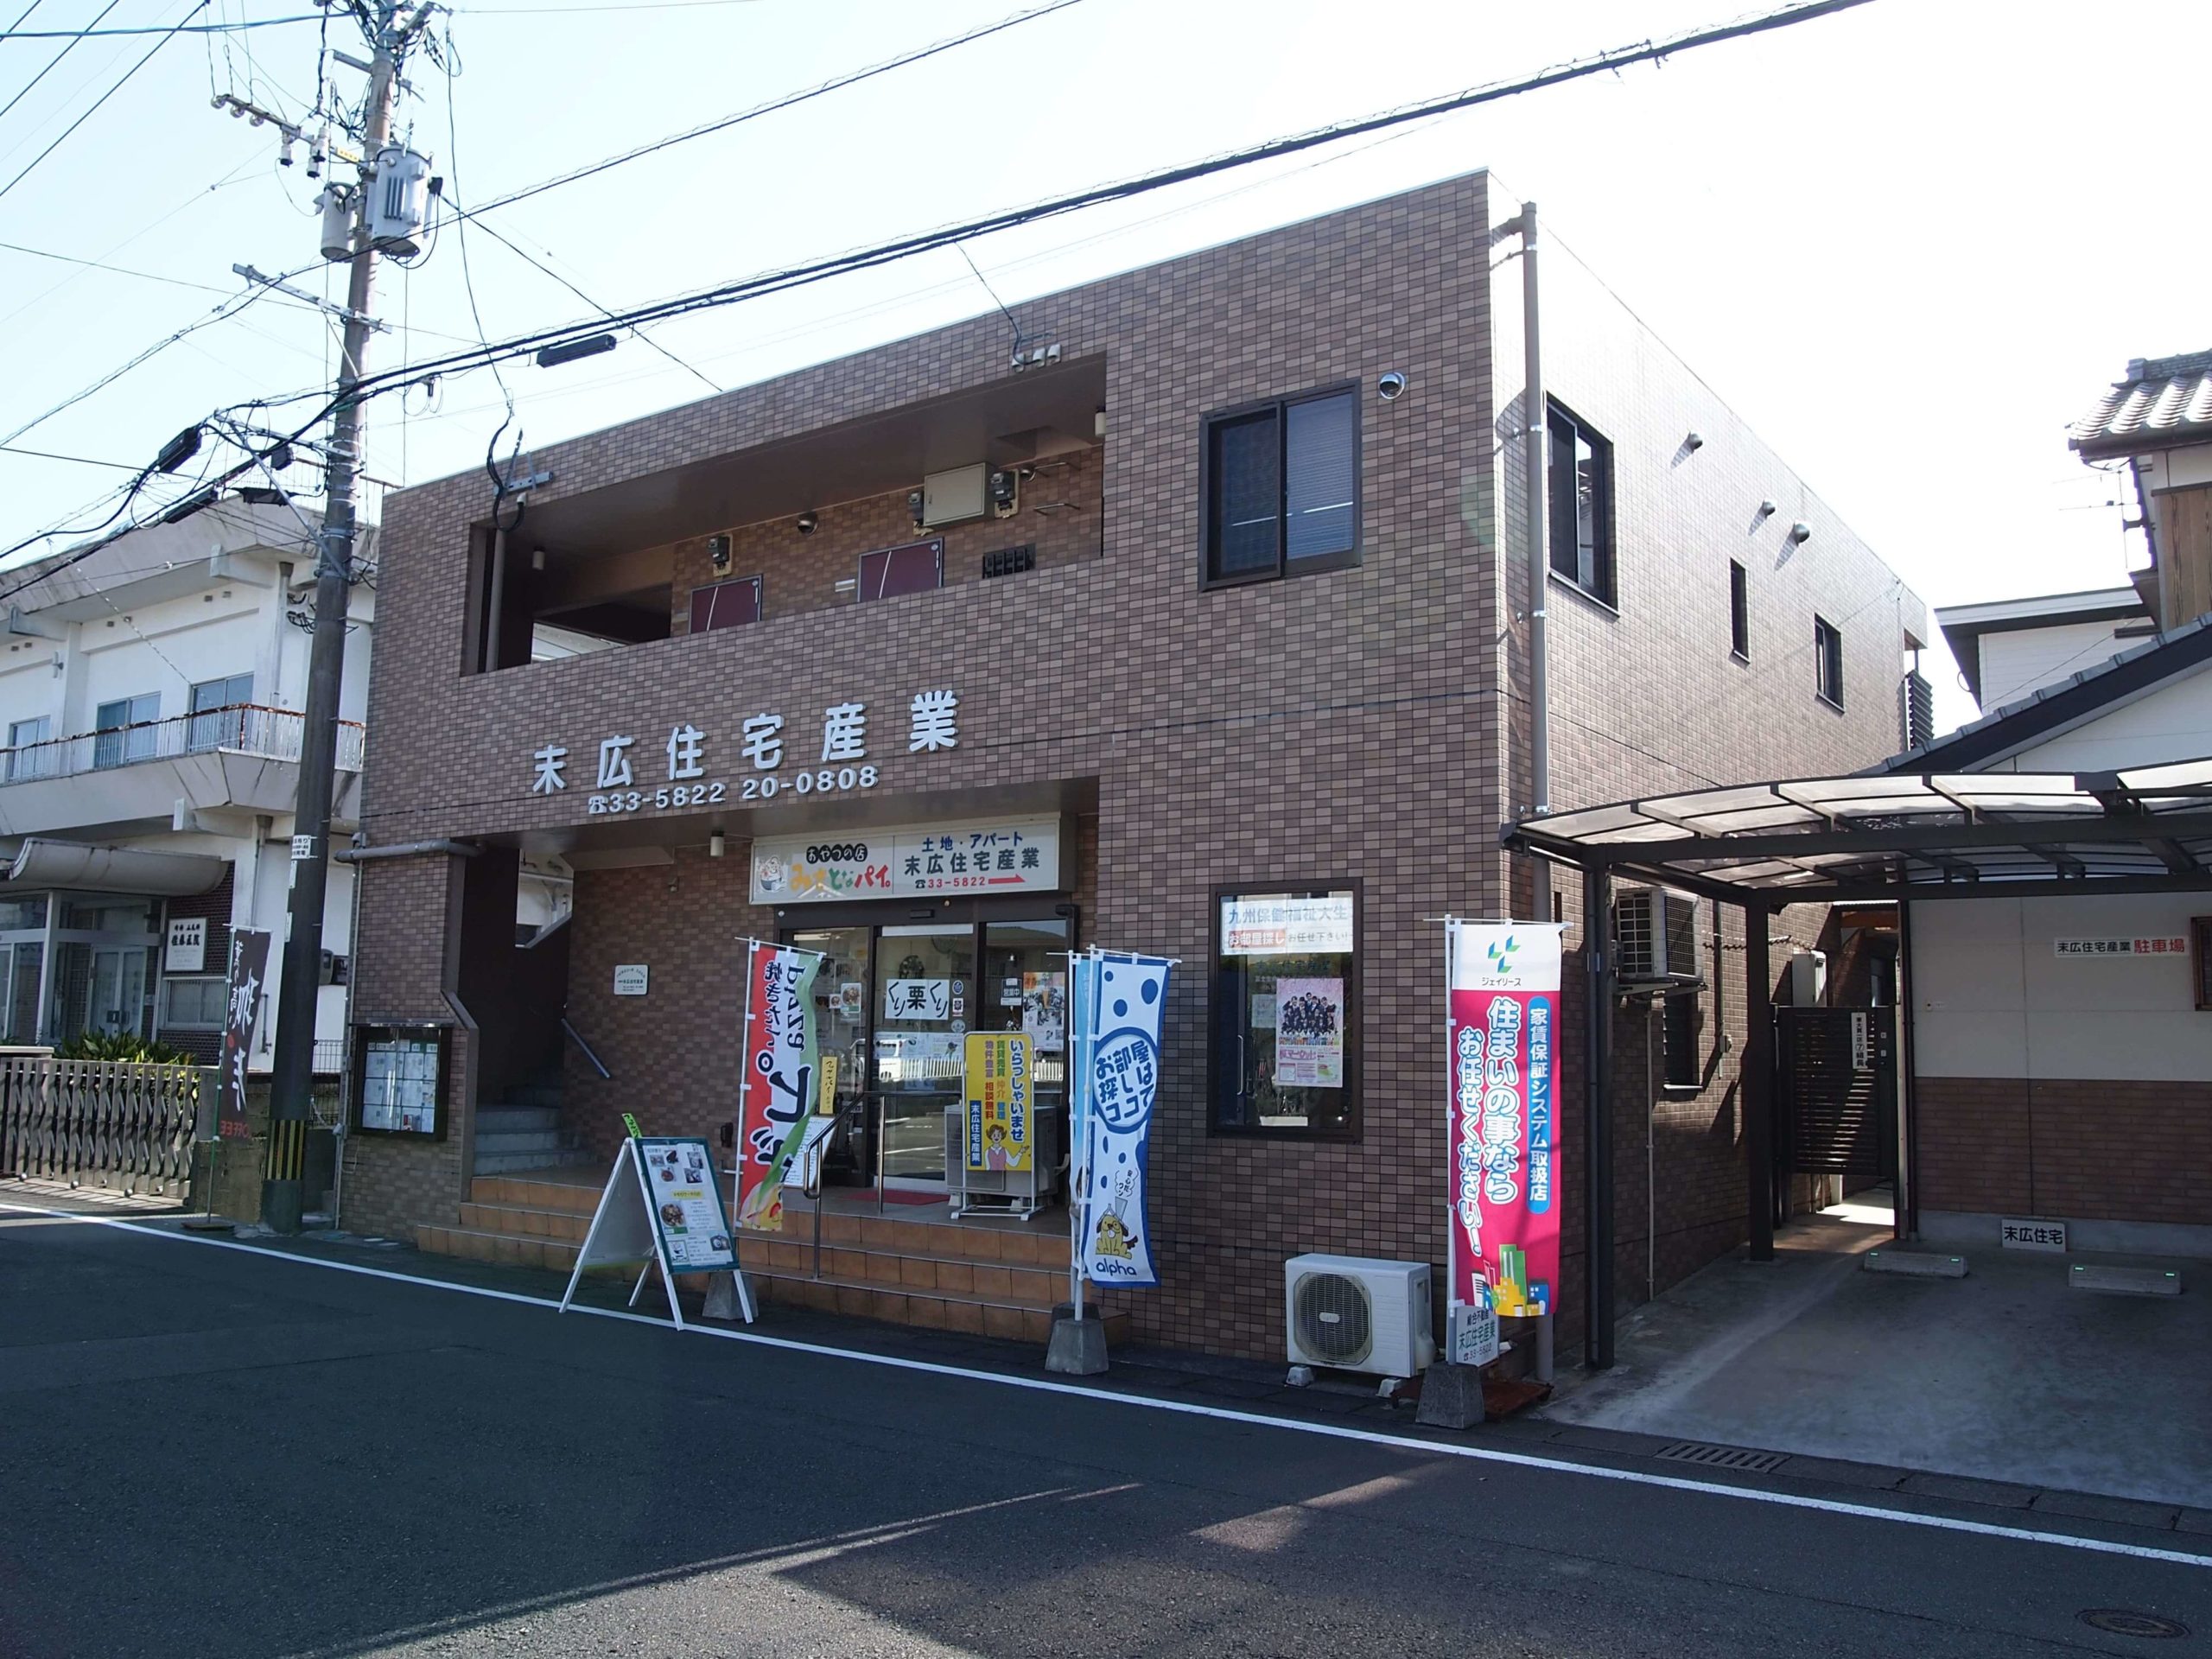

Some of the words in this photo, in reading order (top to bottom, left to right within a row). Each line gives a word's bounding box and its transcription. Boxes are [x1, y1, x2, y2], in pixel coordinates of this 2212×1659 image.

[532, 690, 958, 794] 末広住宅産業
[607, 782, 727, 814] 33-5822
[741, 766, 879, 801] 20-0808
[807, 844, 867, 863] おやつの店
[922, 831, 1023, 852] 土地・アパート
[905, 847, 1039, 876] 末広住宅産業
[928, 876, 986, 888] 33-5822
[1229, 930, 1285, 946] お部屋探し
[2057, 941, 2131, 953] 末広住宅産業
[2134, 938, 2185, 954] 駐車場
[1481, 977, 1522, 987] ジェイリース
[1096, 1040, 1149, 1080] お部屋
[1010, 1039, 1025, 1141] いらっしゃいませ
[1098, 1062, 1153, 1103] 探しは
[1106, 1084, 1154, 1122] ココで
[1484, 997, 1521, 1203] 住まいの事なら
[1529, 1008, 1548, 1201] 家賃保証システム取扱店
[971, 1104, 981, 1162] 末広住宅産業
[2004, 1226, 2063, 1244] 末広住宅
[1096, 1258, 1137, 1276] alpha
